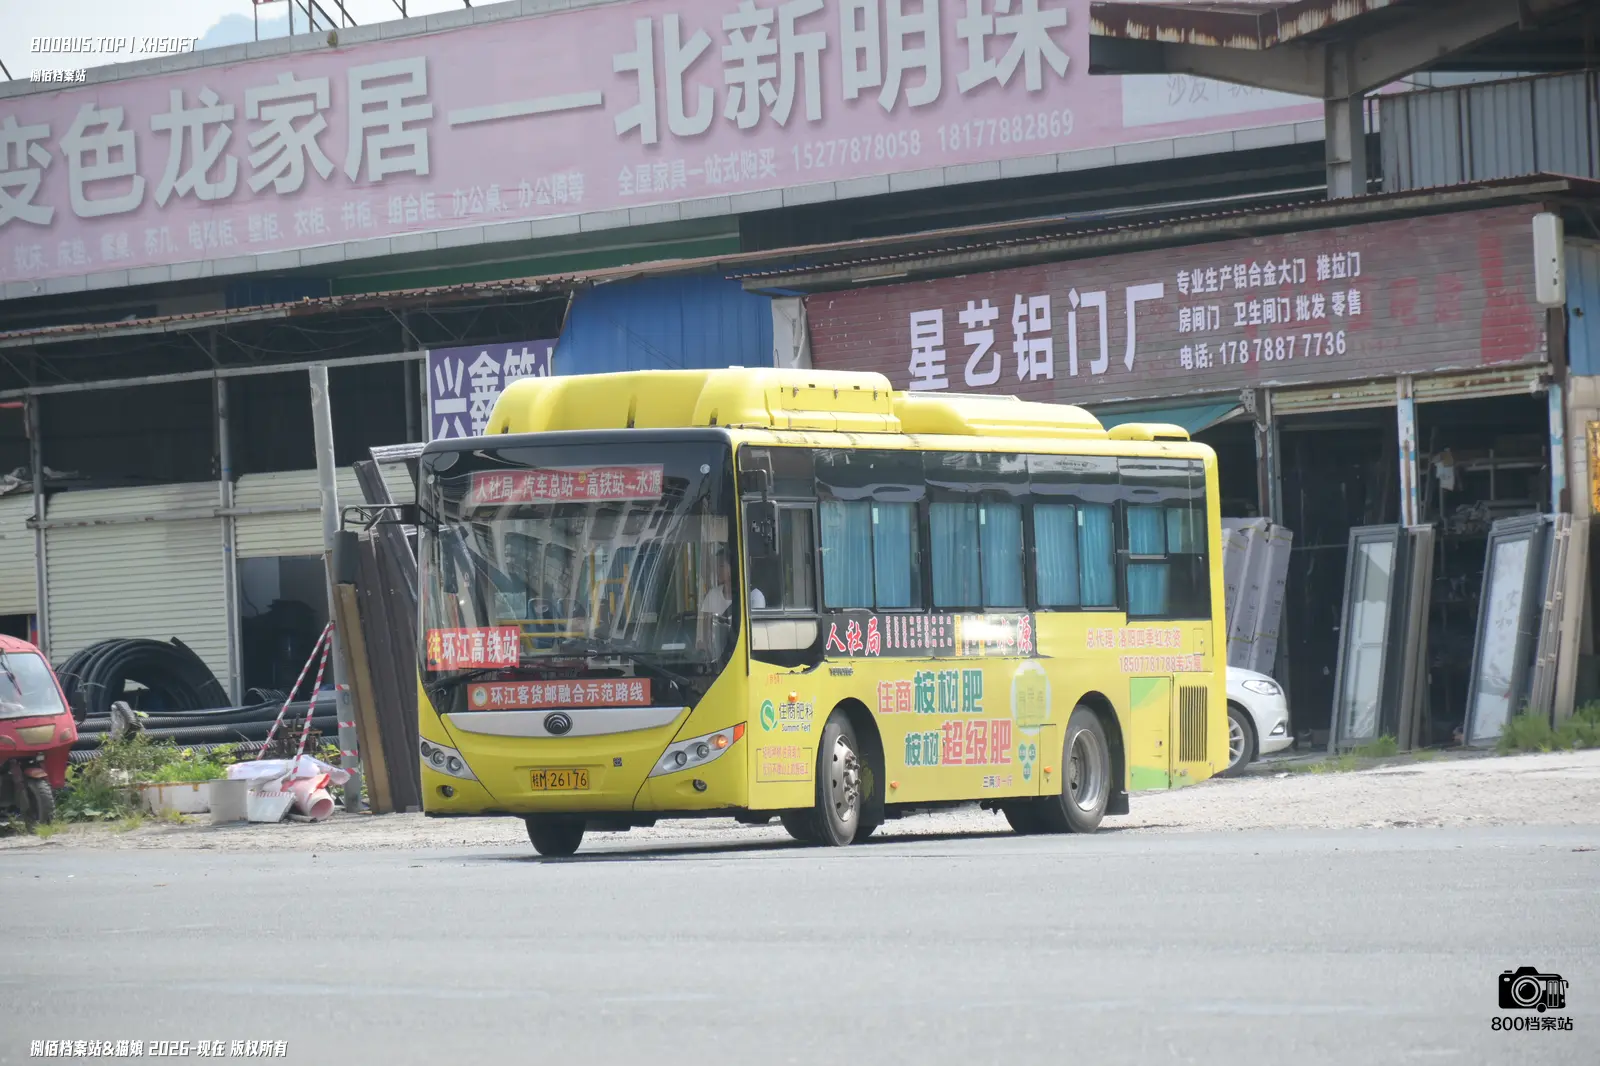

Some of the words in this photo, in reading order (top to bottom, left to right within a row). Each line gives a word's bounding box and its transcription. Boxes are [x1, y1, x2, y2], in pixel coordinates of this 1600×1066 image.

[617, 147, 777, 197] 全屋家具一站式购买
[791, 134, 921, 171] 15277878058
[937, 109, 1075, 152] 18177882869
[1177, 258, 1306, 295] 专业生产铝合金大门
[1316, 251, 1361, 281] 推拉门
[1179, 305, 1220, 333] 房间门
[1296, 293, 1326, 322] 批发
[1332, 288, 1361, 317] 零售
[908, 282, 1165, 391] 星艺铝门厂
[826, 616, 881, 656] 人社局
[490, 682, 645, 706] 环江客货邮融合示范路线
